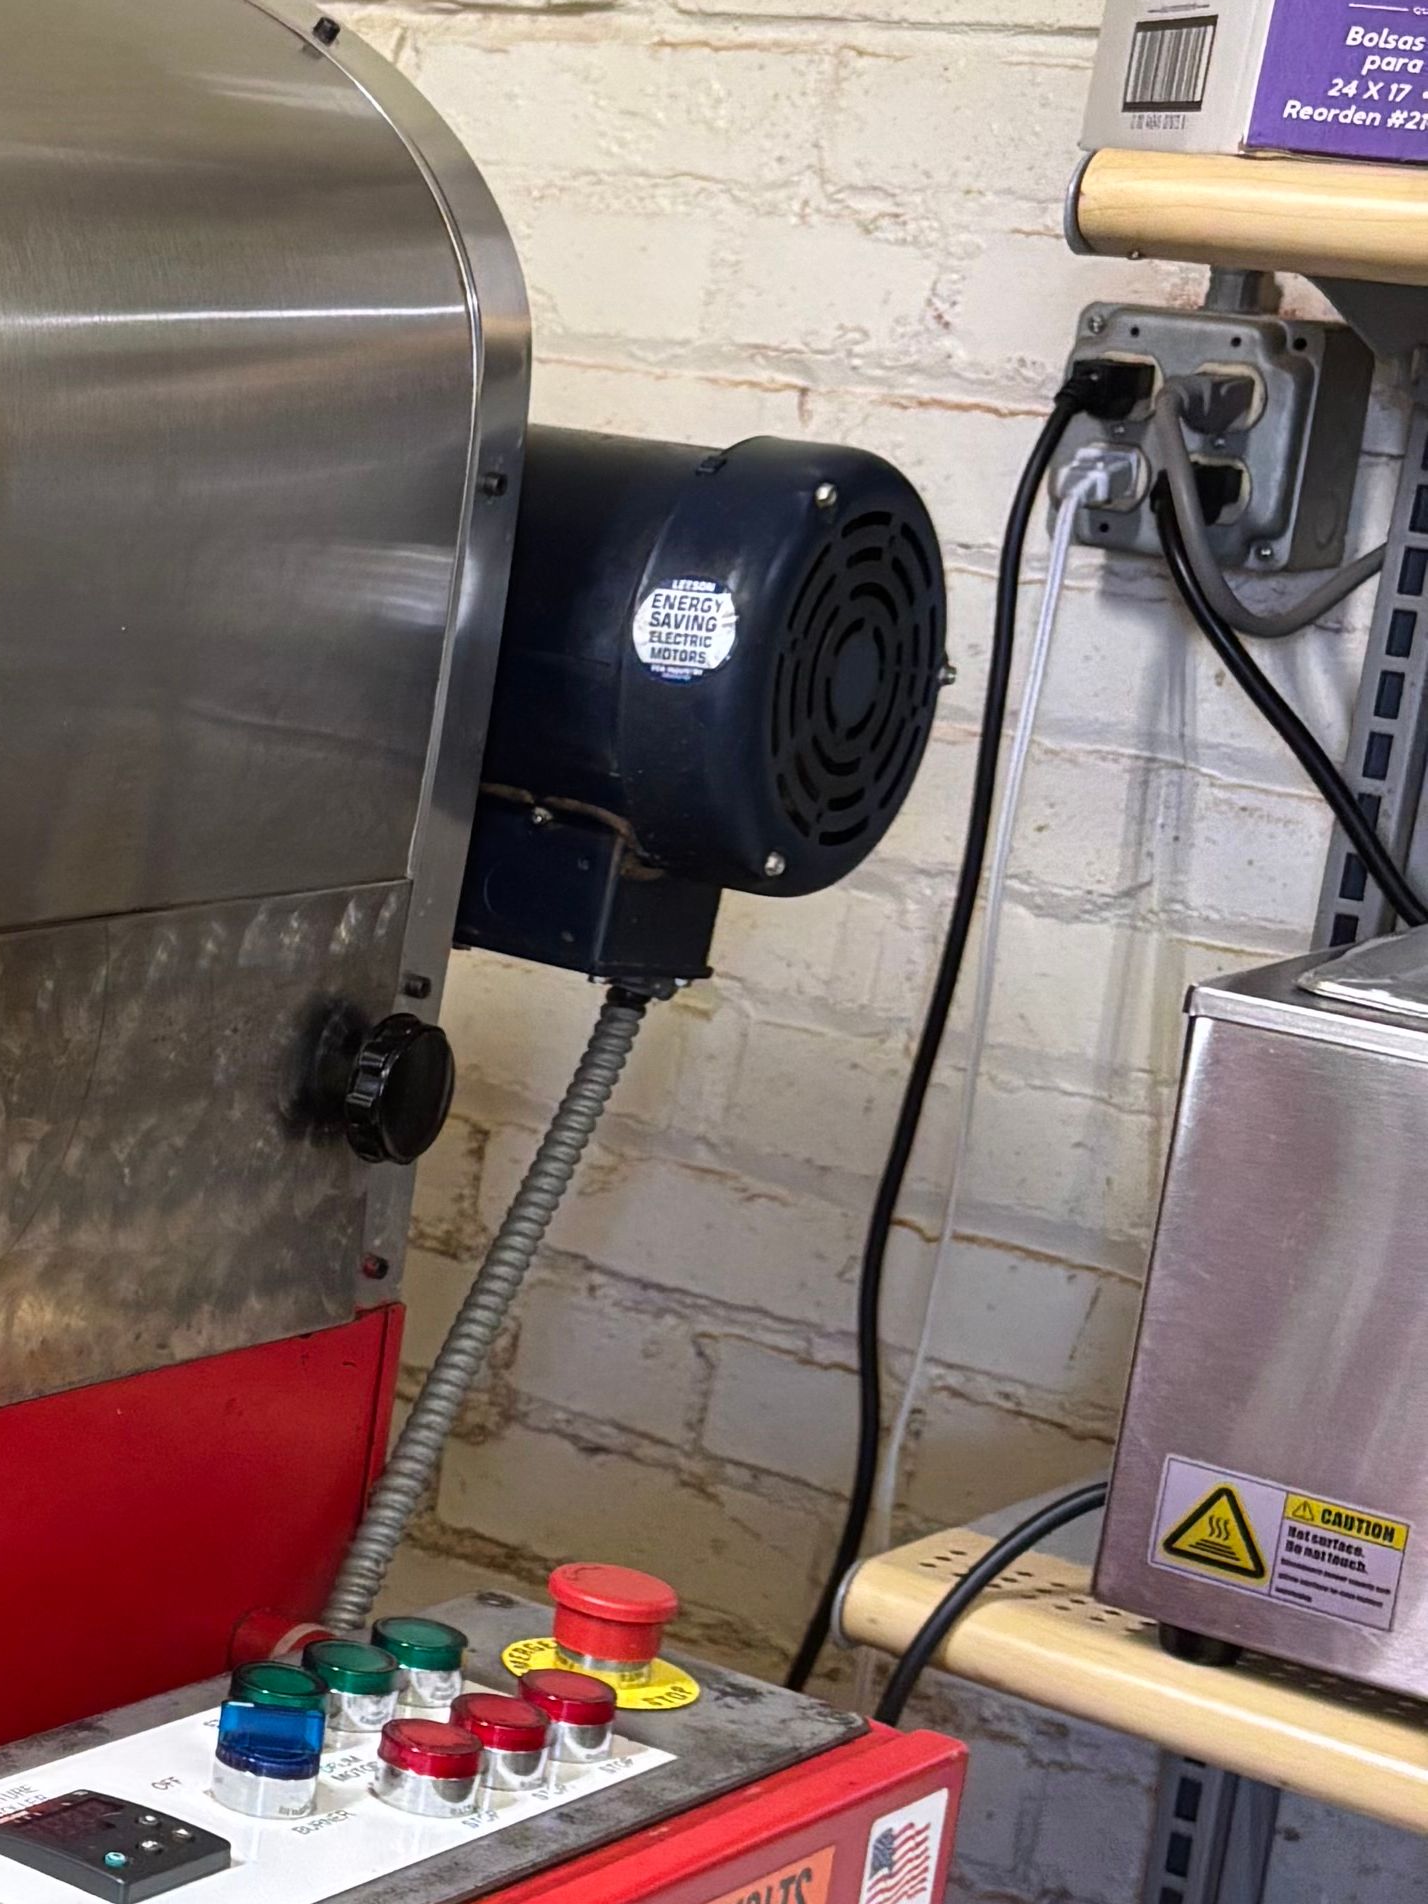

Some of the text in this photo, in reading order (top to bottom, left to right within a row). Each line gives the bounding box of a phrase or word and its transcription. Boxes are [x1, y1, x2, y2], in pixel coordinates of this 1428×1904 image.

[1345, 25, 1427, 51] Bolsas
[1361, 54, 1425, 76] para
[1328, 78, 1412, 102] 24 X 17
[1283, 99, 1382, 126] Reorden
[651, 593, 723, 613] ENERGY
[648, 611, 717, 632] SAVING
[648, 630, 712, 648] ELECTRIC
[649, 646, 706, 664] MOTORS
[1320, 1508, 1396, 1543] CAUTION
[642, 1684, 692, 1707] STOP
[151, 1776, 183, 1792] OFF
[291, 1808, 356, 1835] BURNER
